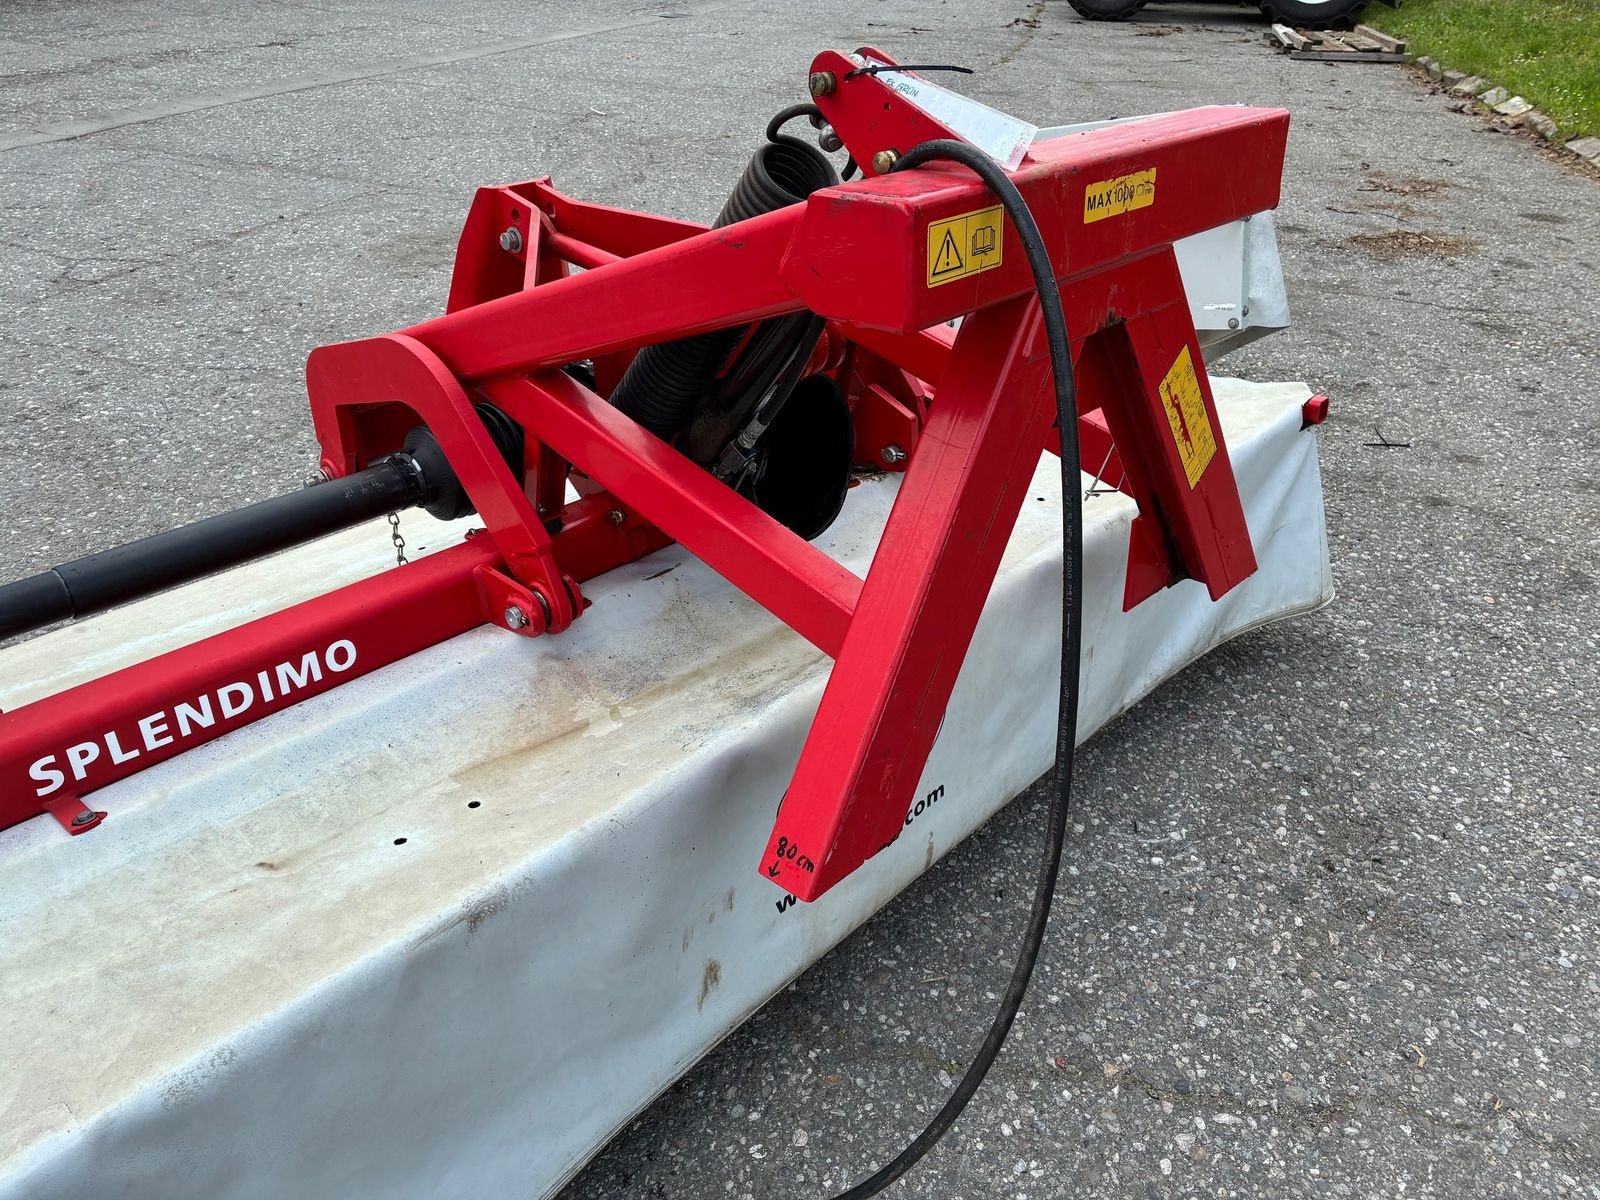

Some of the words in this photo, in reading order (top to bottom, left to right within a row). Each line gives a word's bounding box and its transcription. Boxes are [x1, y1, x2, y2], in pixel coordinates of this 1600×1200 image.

[1087, 190, 1112, 211] MAX
[28, 639, 358, 797] SPLENDIMO
[776, 836, 798, 859] 80
[796, 855, 815, 873] cm
